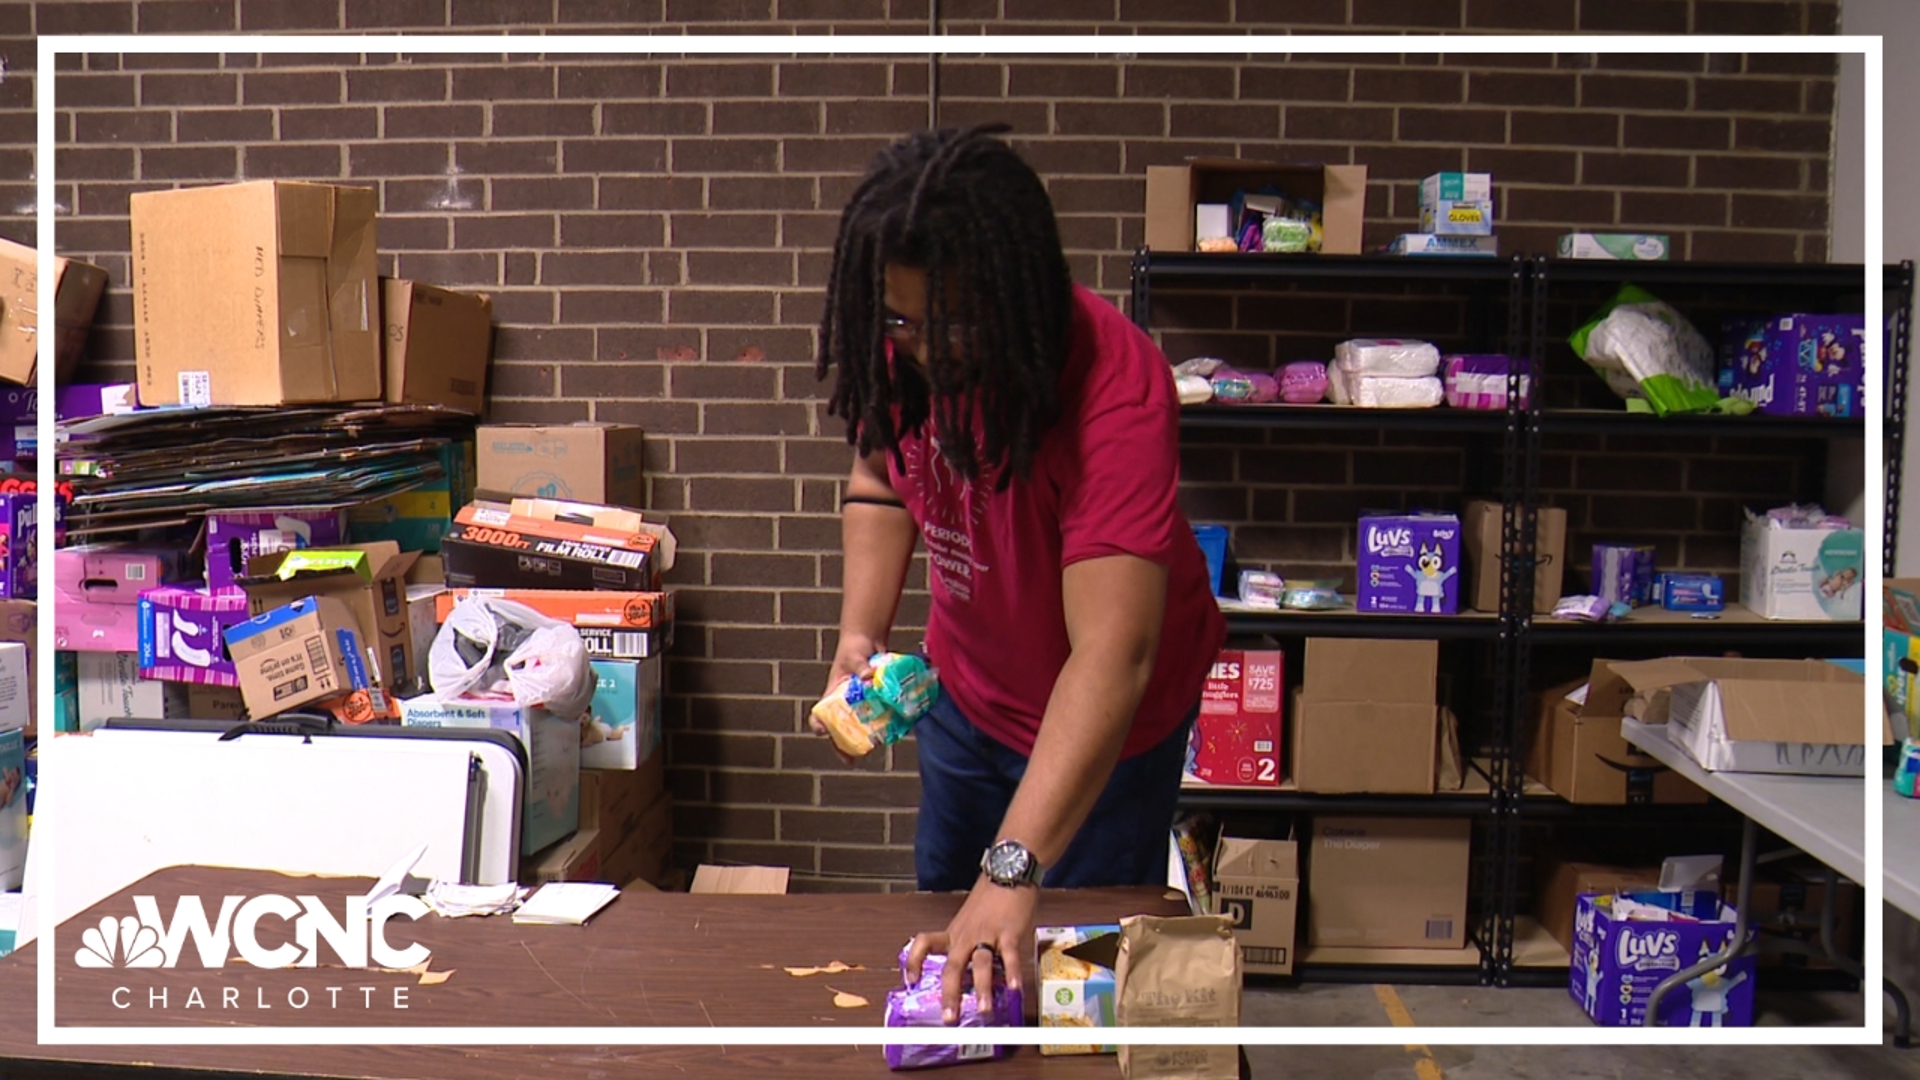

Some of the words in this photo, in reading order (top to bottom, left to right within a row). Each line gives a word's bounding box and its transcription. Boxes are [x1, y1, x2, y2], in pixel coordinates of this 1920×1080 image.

[1448, 214, 1480, 222] GLOVES
[1426, 237, 1477, 249] AMMEX
[535, 542, 571, 558] FILM
[572, 547, 608, 562] ROLL
[580, 628, 612, 637] SERVICE
[1249, 665, 1276, 675] SAVE
[407, 708, 455, 719] Absorbent
[456, 708, 464, 719] &
[465, 708, 486, 719] Soft
[512, 710, 520, 726] 1
[407, 718, 442, 728] Diapers
[1257, 757, 1276, 781] 2
[1323, 838, 1343, 849] The
[1345, 838, 1381, 851] Diaper
[1228, 902, 1245, 925] D
[1141, 990, 1182, 1007] The
[1184, 986, 1217, 1003] Kit
